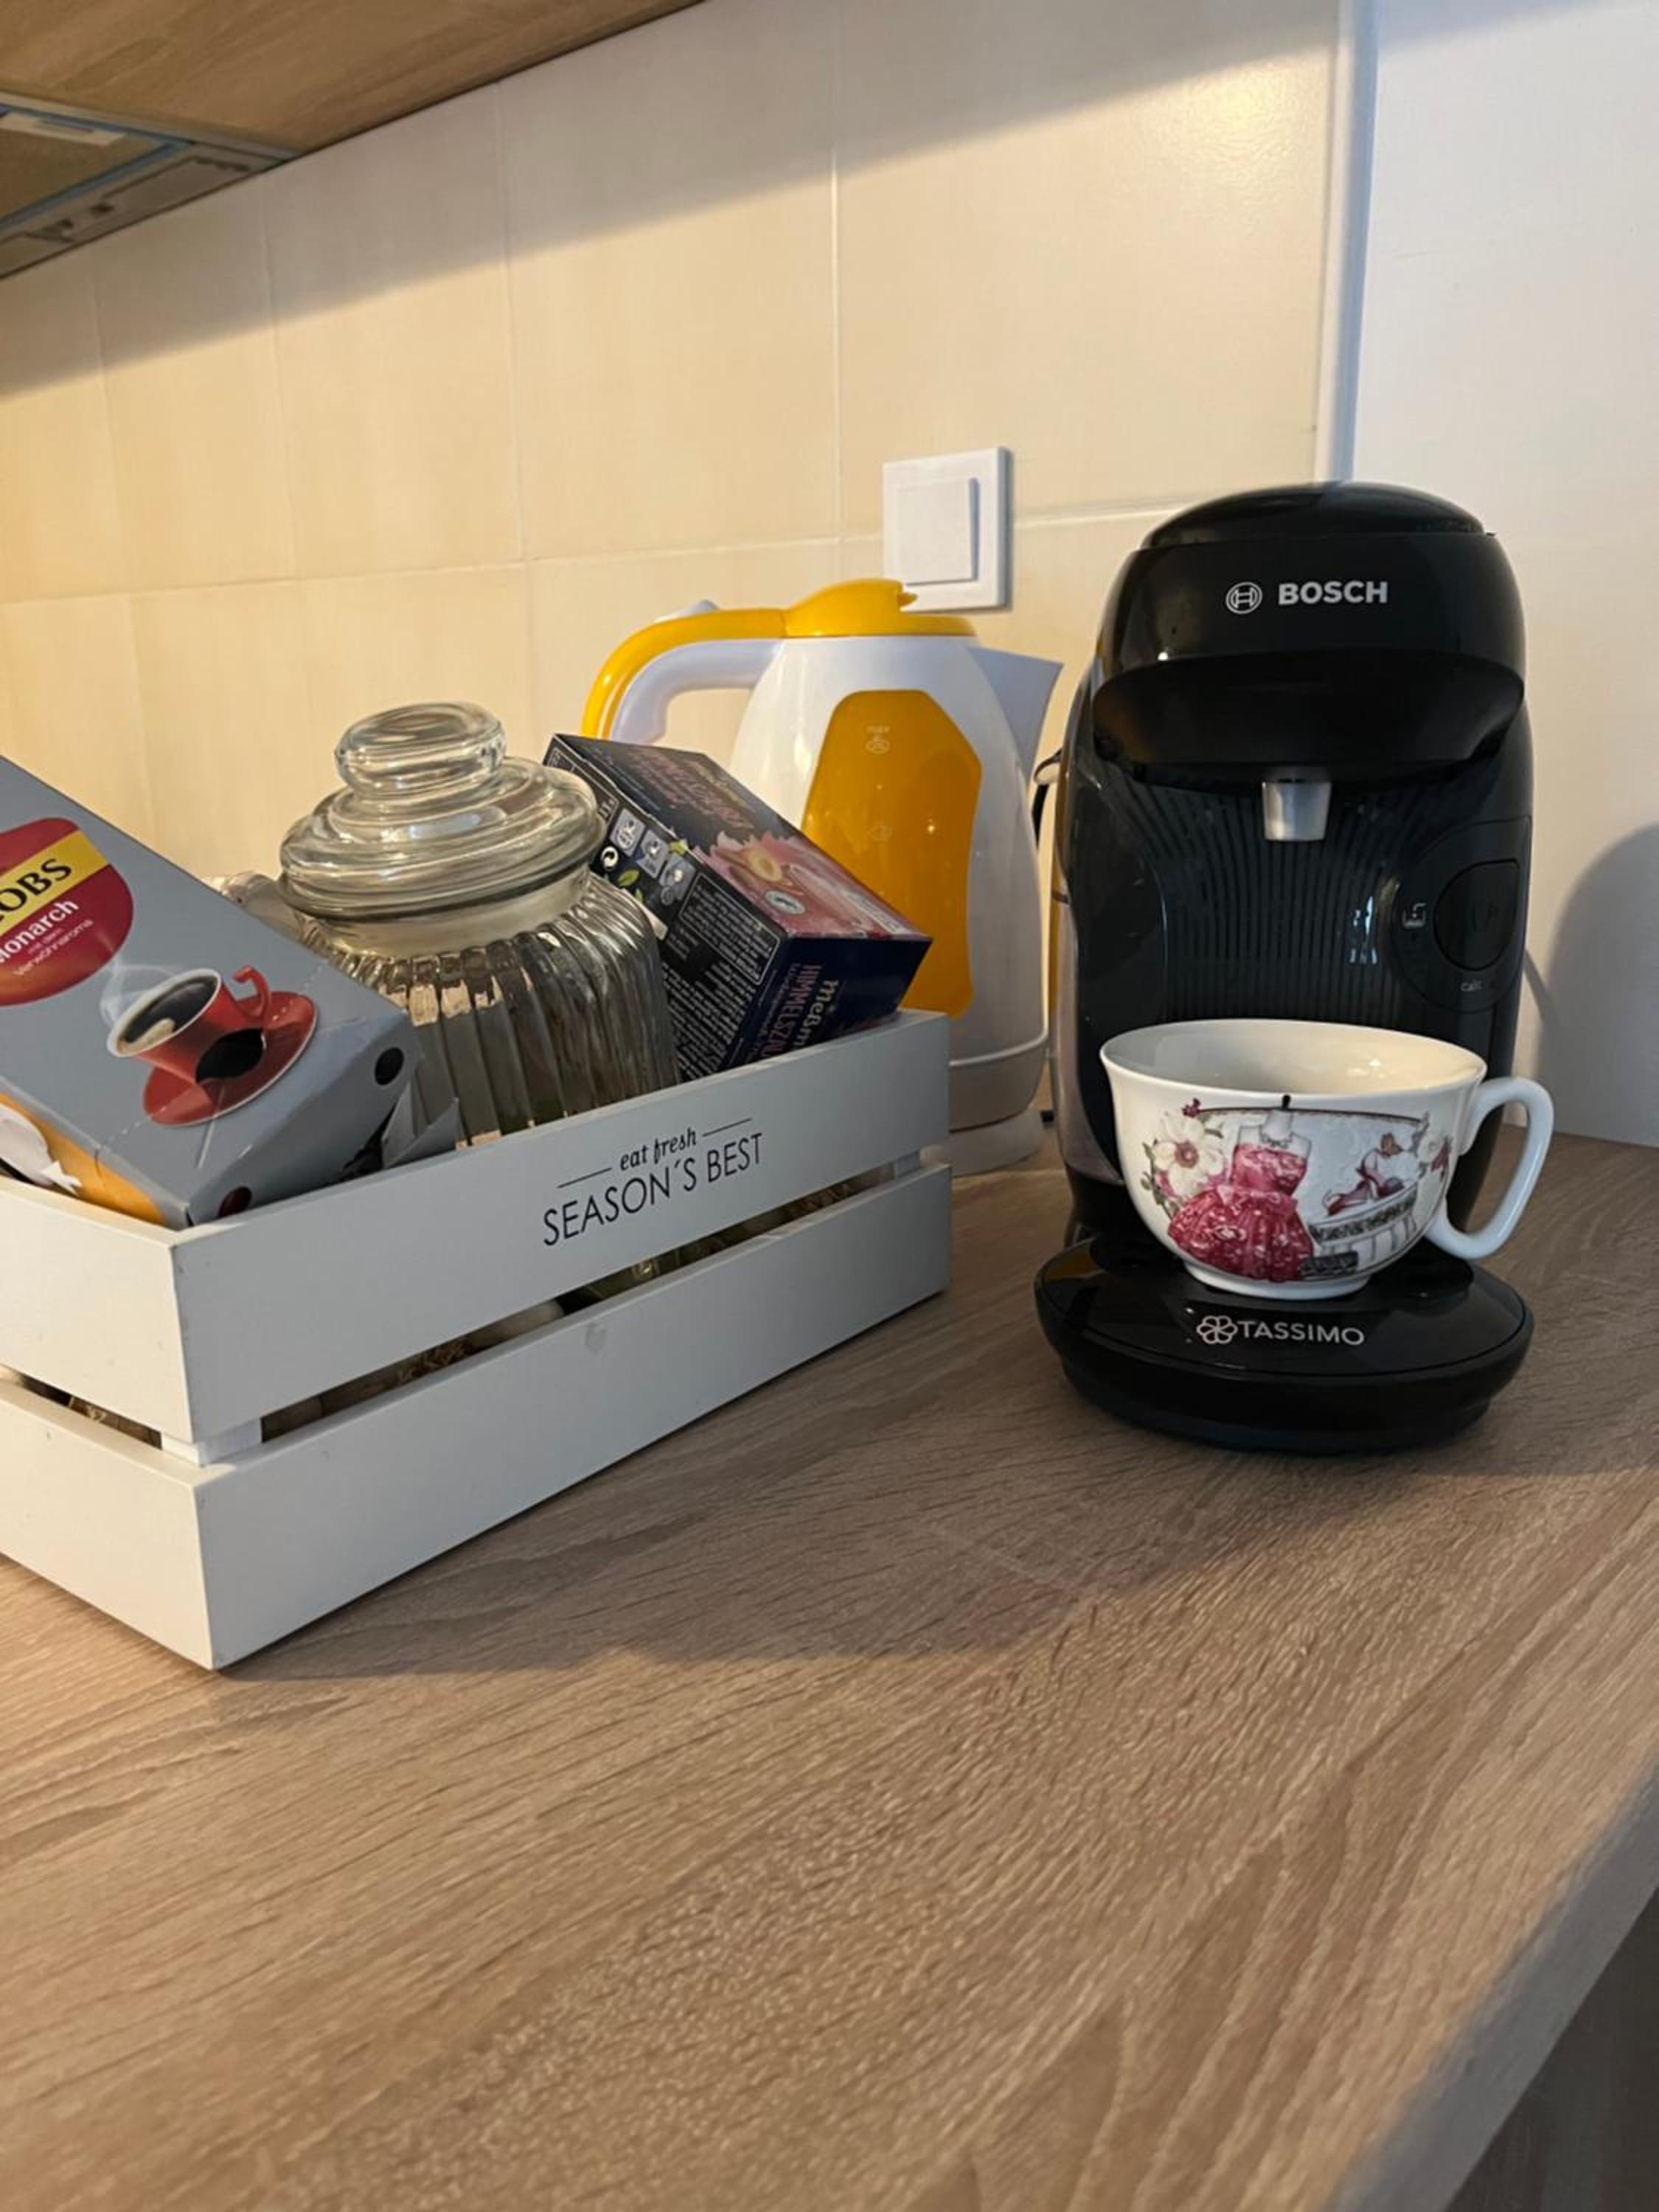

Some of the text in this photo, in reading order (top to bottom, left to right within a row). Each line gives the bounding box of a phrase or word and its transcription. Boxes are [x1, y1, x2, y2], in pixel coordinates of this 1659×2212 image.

[1278, 580, 1388, 605] BOSCH
[0, 858, 72, 921] OBS
[620, 1127, 697, 1171] eat fresh
[707, 1133, 762, 1183] BEST
[1237, 1321, 1365, 1346] TASSIMO
